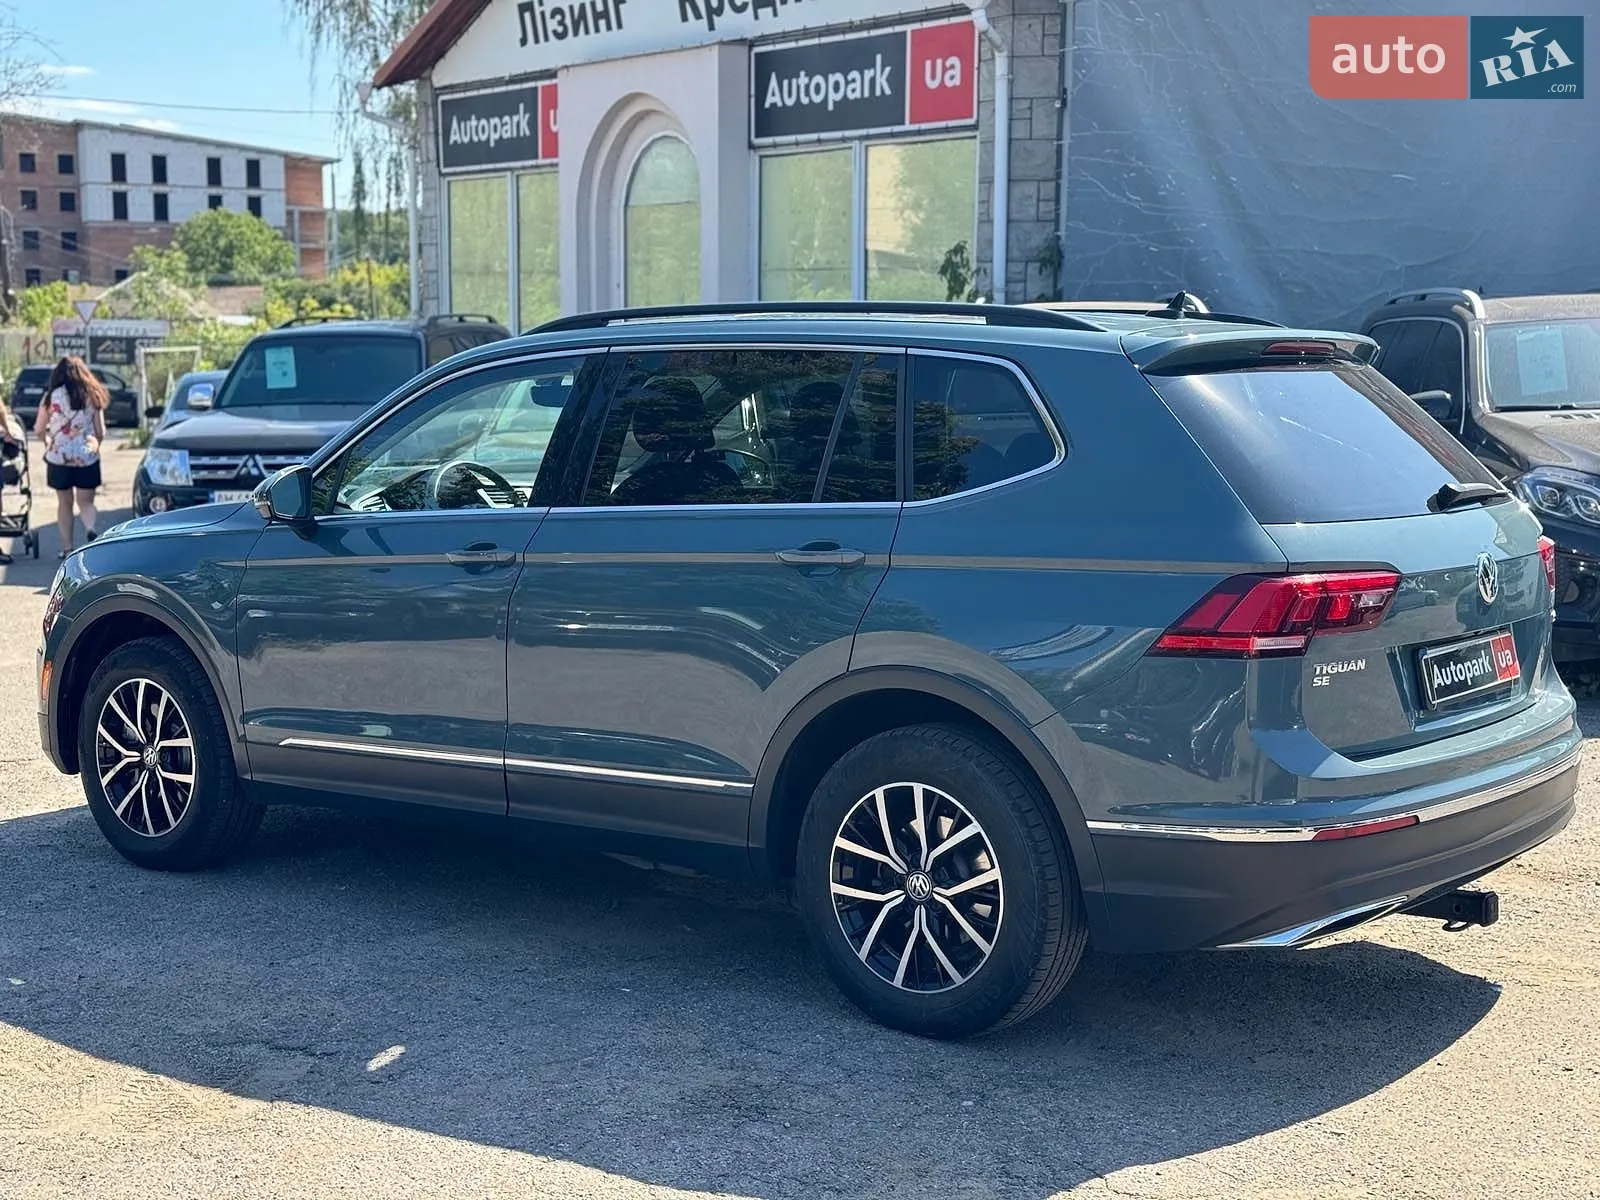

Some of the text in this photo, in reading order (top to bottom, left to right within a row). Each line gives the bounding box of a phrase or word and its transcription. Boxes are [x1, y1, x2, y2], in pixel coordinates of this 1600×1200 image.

[517, 0, 627, 48] Лізинг
[764, 53, 962, 111] Autopark ua
[449, 103, 531, 147] Autopark
[1312, 675, 1331, 687] SE
[1313, 658, 1366, 675] TIGUAN
[1431, 651, 1513, 690] Autopark ua
